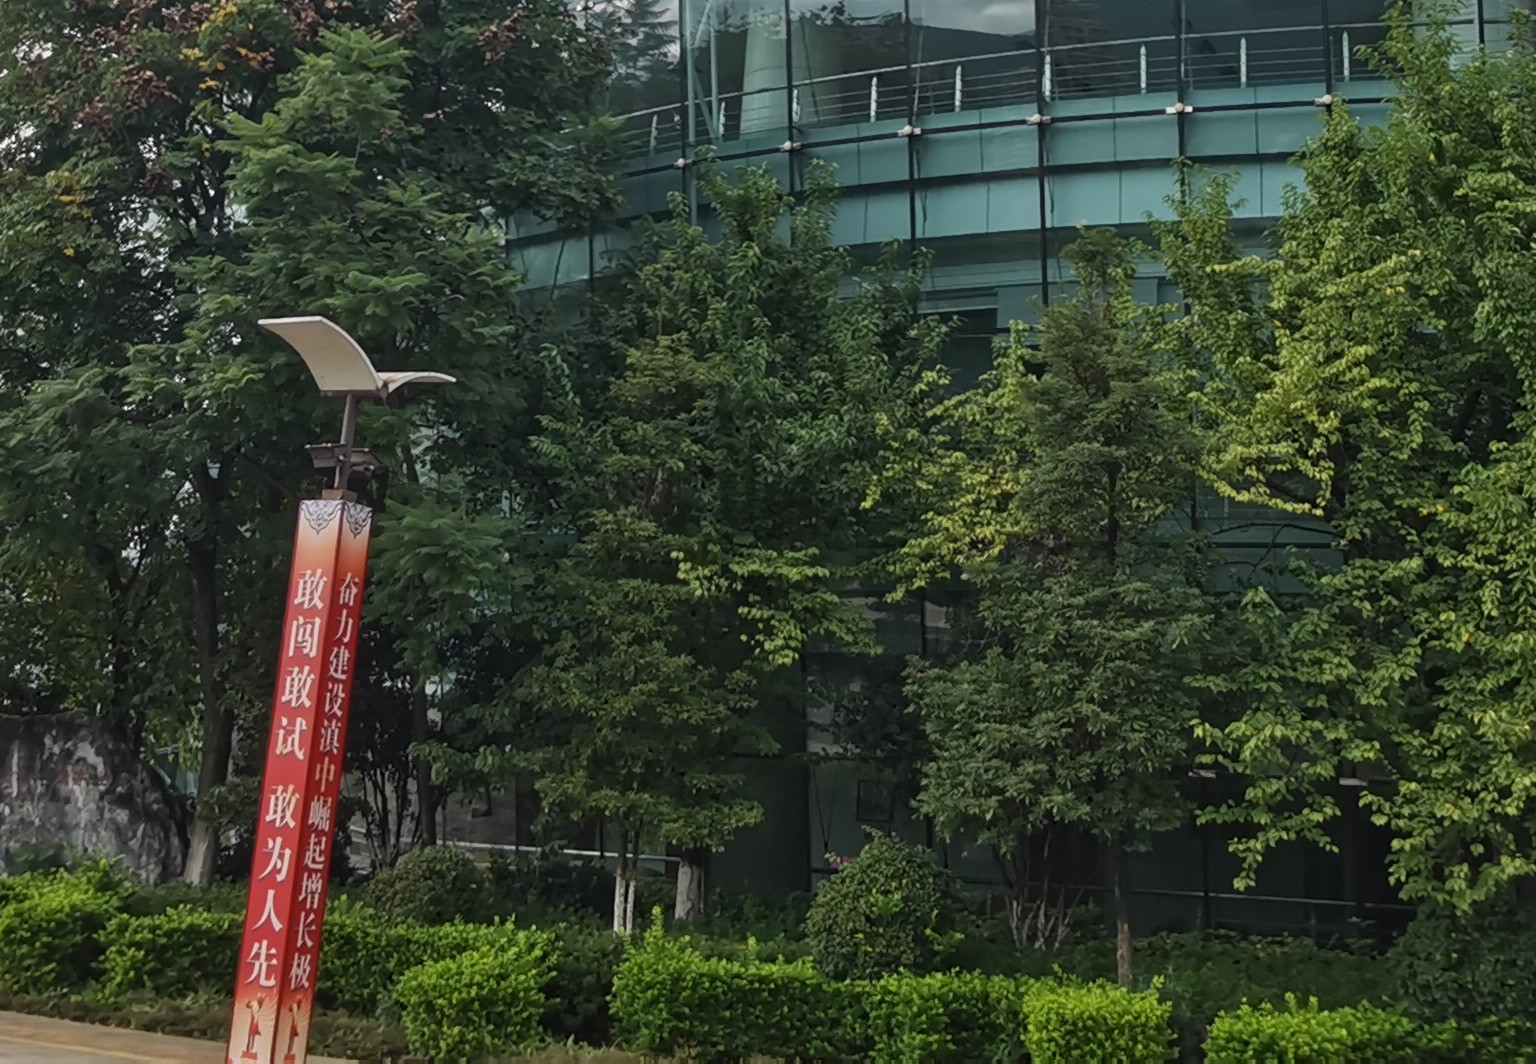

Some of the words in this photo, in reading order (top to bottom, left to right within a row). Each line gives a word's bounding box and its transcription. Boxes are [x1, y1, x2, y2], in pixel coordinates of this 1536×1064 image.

[274, 568, 328, 761] 敢闯敢试
[289, 571, 360, 991] 奋力建设滇中崛起增长极
[245, 782, 301, 988] 敢为人先
